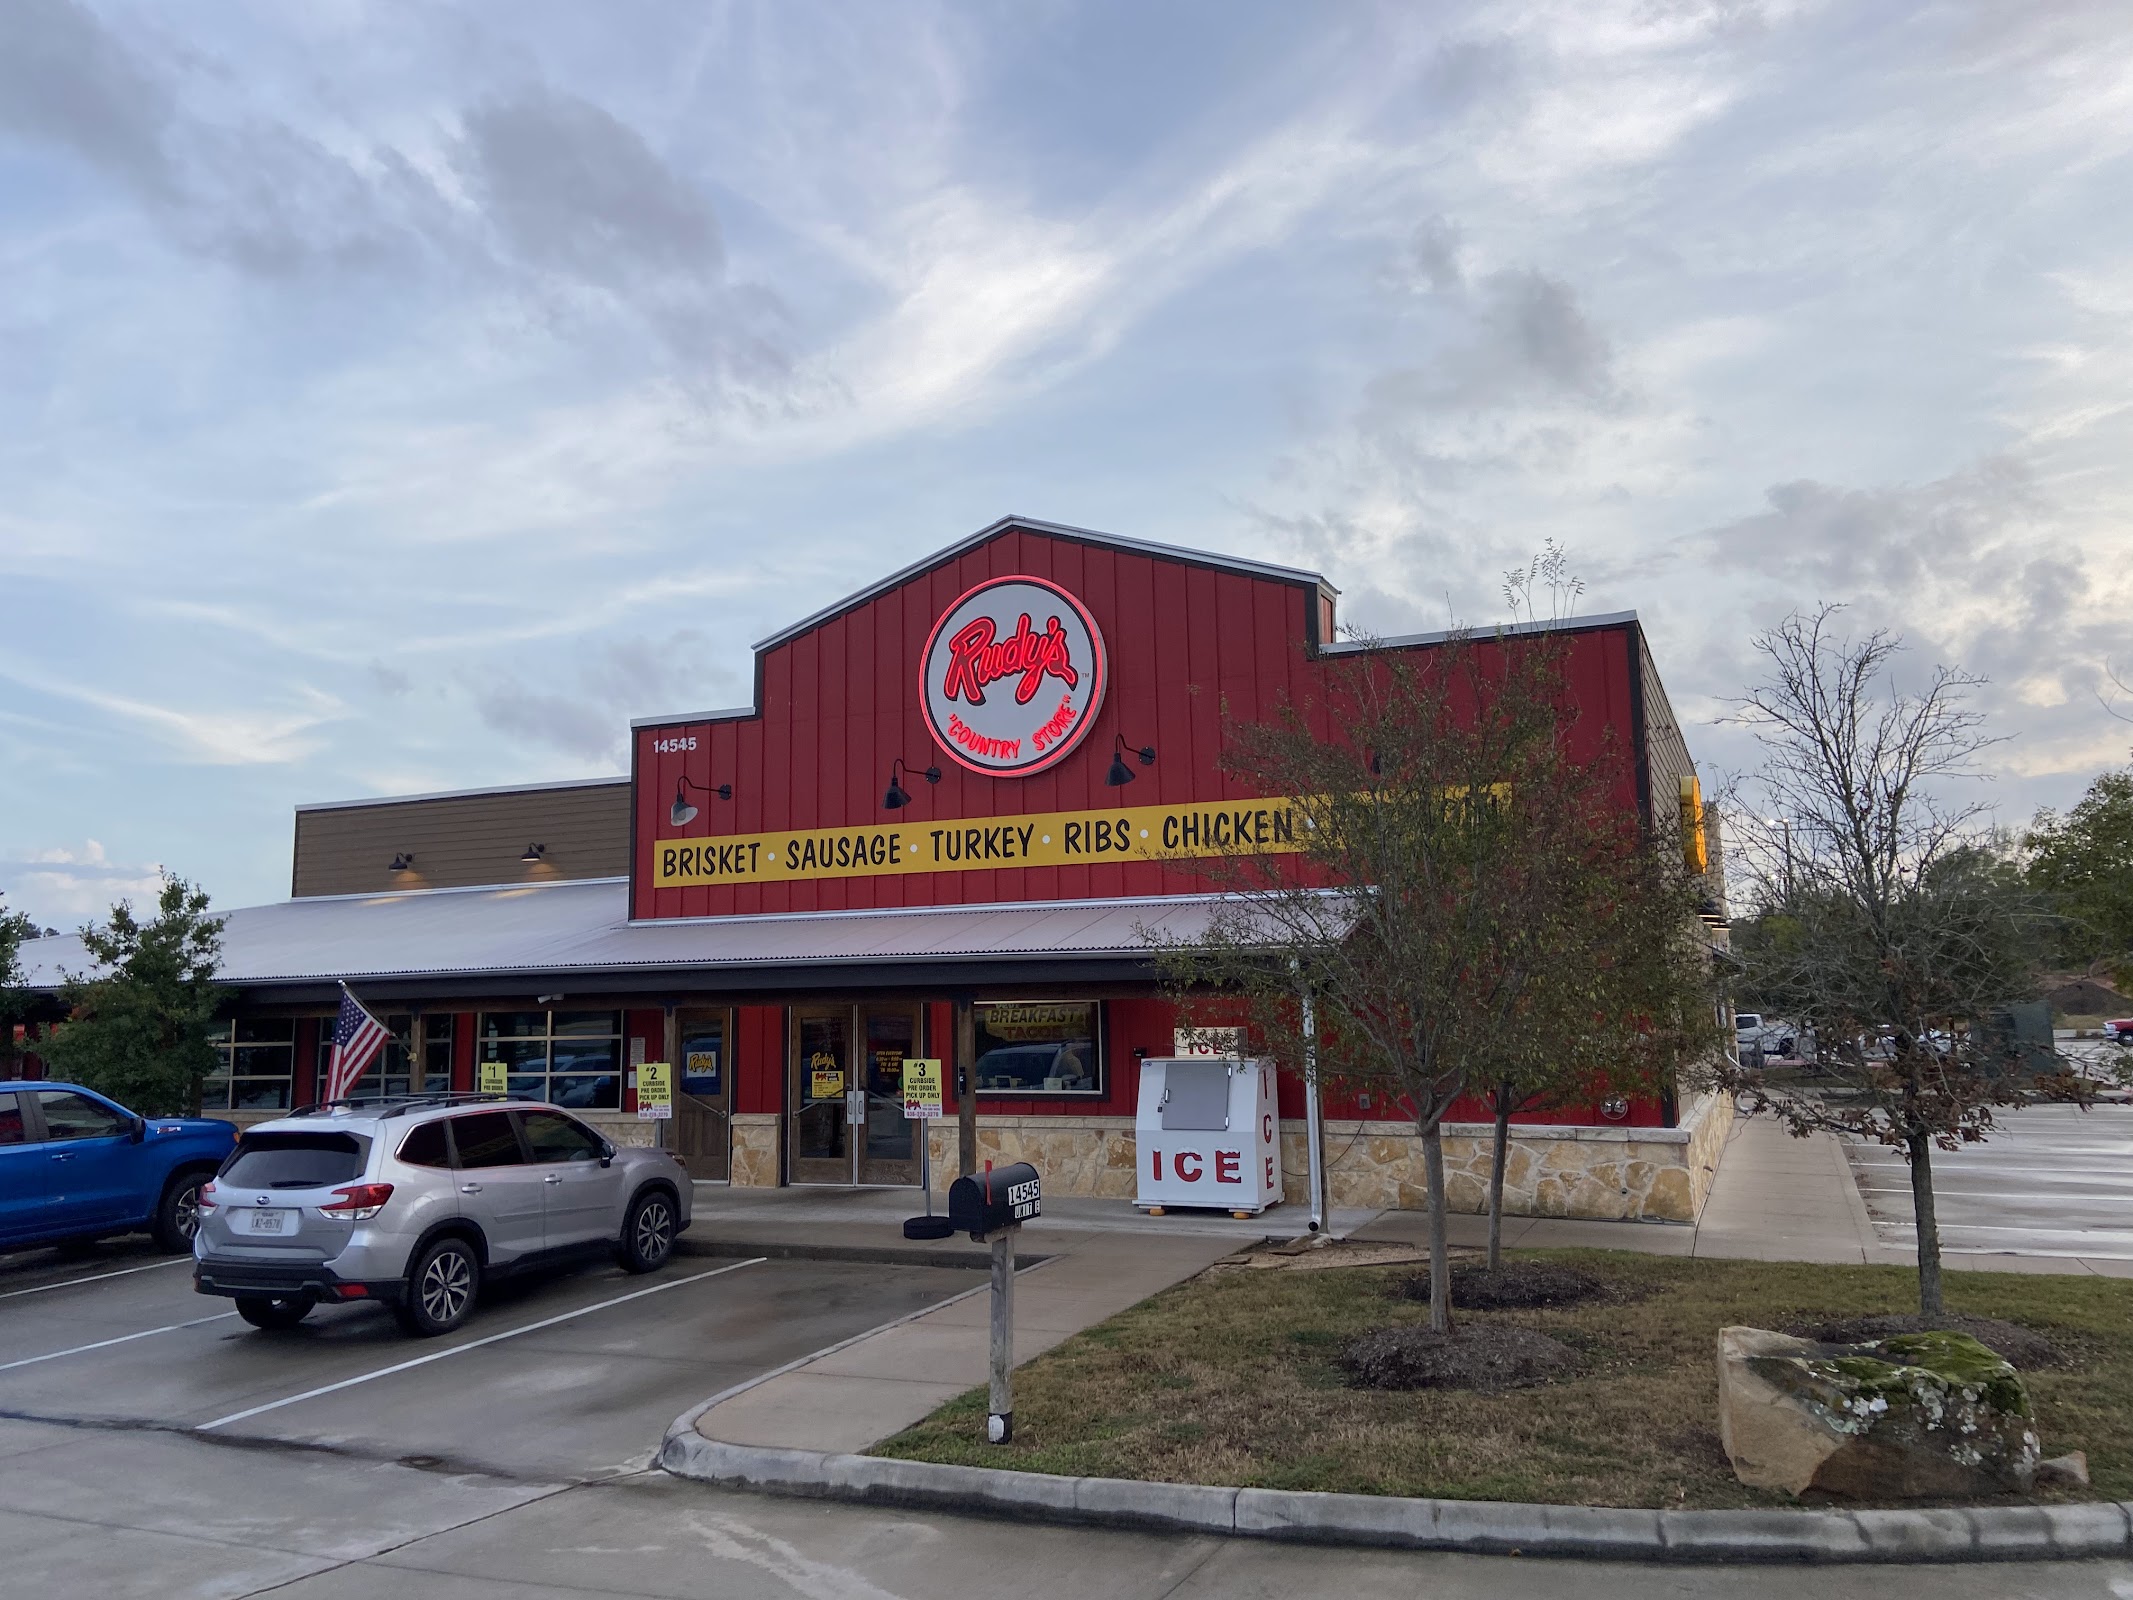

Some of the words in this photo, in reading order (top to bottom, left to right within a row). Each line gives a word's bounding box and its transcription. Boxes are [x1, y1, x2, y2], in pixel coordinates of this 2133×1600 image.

[944, 613, 1079, 706] Rudy's
[653, 736, 697, 753] 14545
[663, 842, 761, 878] BRISKET
[785, 833, 901, 871] SAUSAGE
[930, 823, 1034, 862] TURKEY
[1064, 818, 1131, 855] RIBS
[1162, 807, 1293, 849] CHICKEN
[990, 1008, 1075, 1023] BREAKFAST
[810, 1052, 836, 1070] Rudy's
[1152, 1147, 1242, 1183] ICE
[1010, 1181, 1038, 1204] 14545
[1015, 1203, 1031, 1217] UNIT
